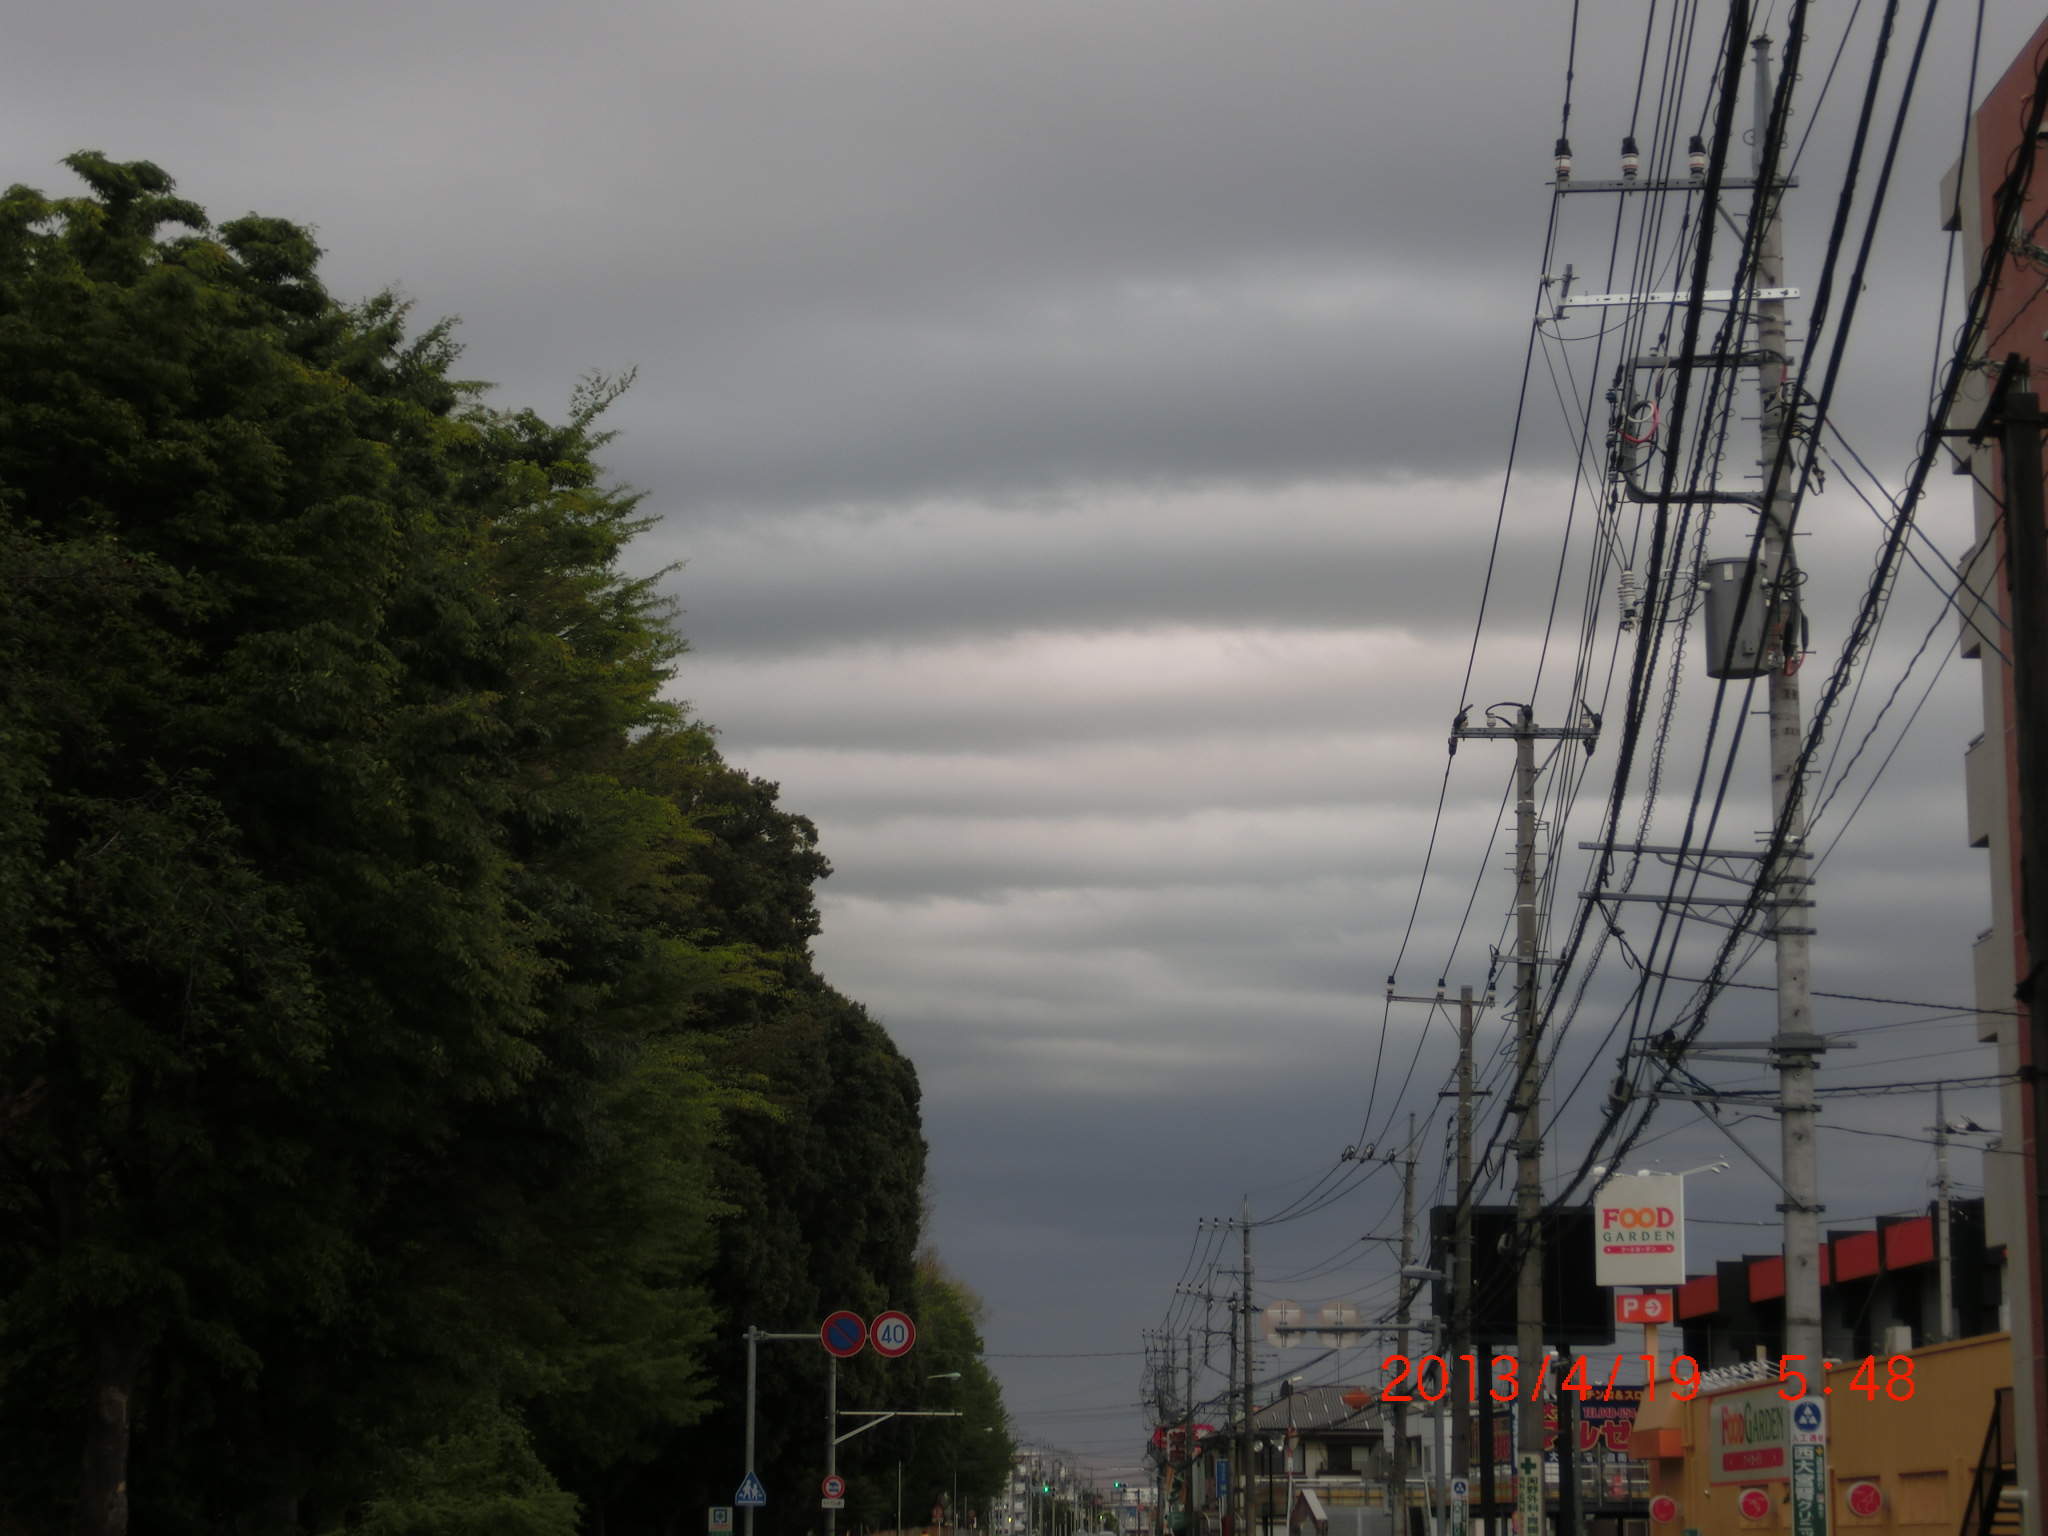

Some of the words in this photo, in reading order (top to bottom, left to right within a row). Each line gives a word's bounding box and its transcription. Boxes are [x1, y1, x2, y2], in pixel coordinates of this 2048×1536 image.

[1602, 1207, 1674, 1229] FOOD
[1603, 1231, 1674, 1242] GARDEN
[1623, 1298, 1639, 1318] P
[881, 1324, 904, 1343] 40
